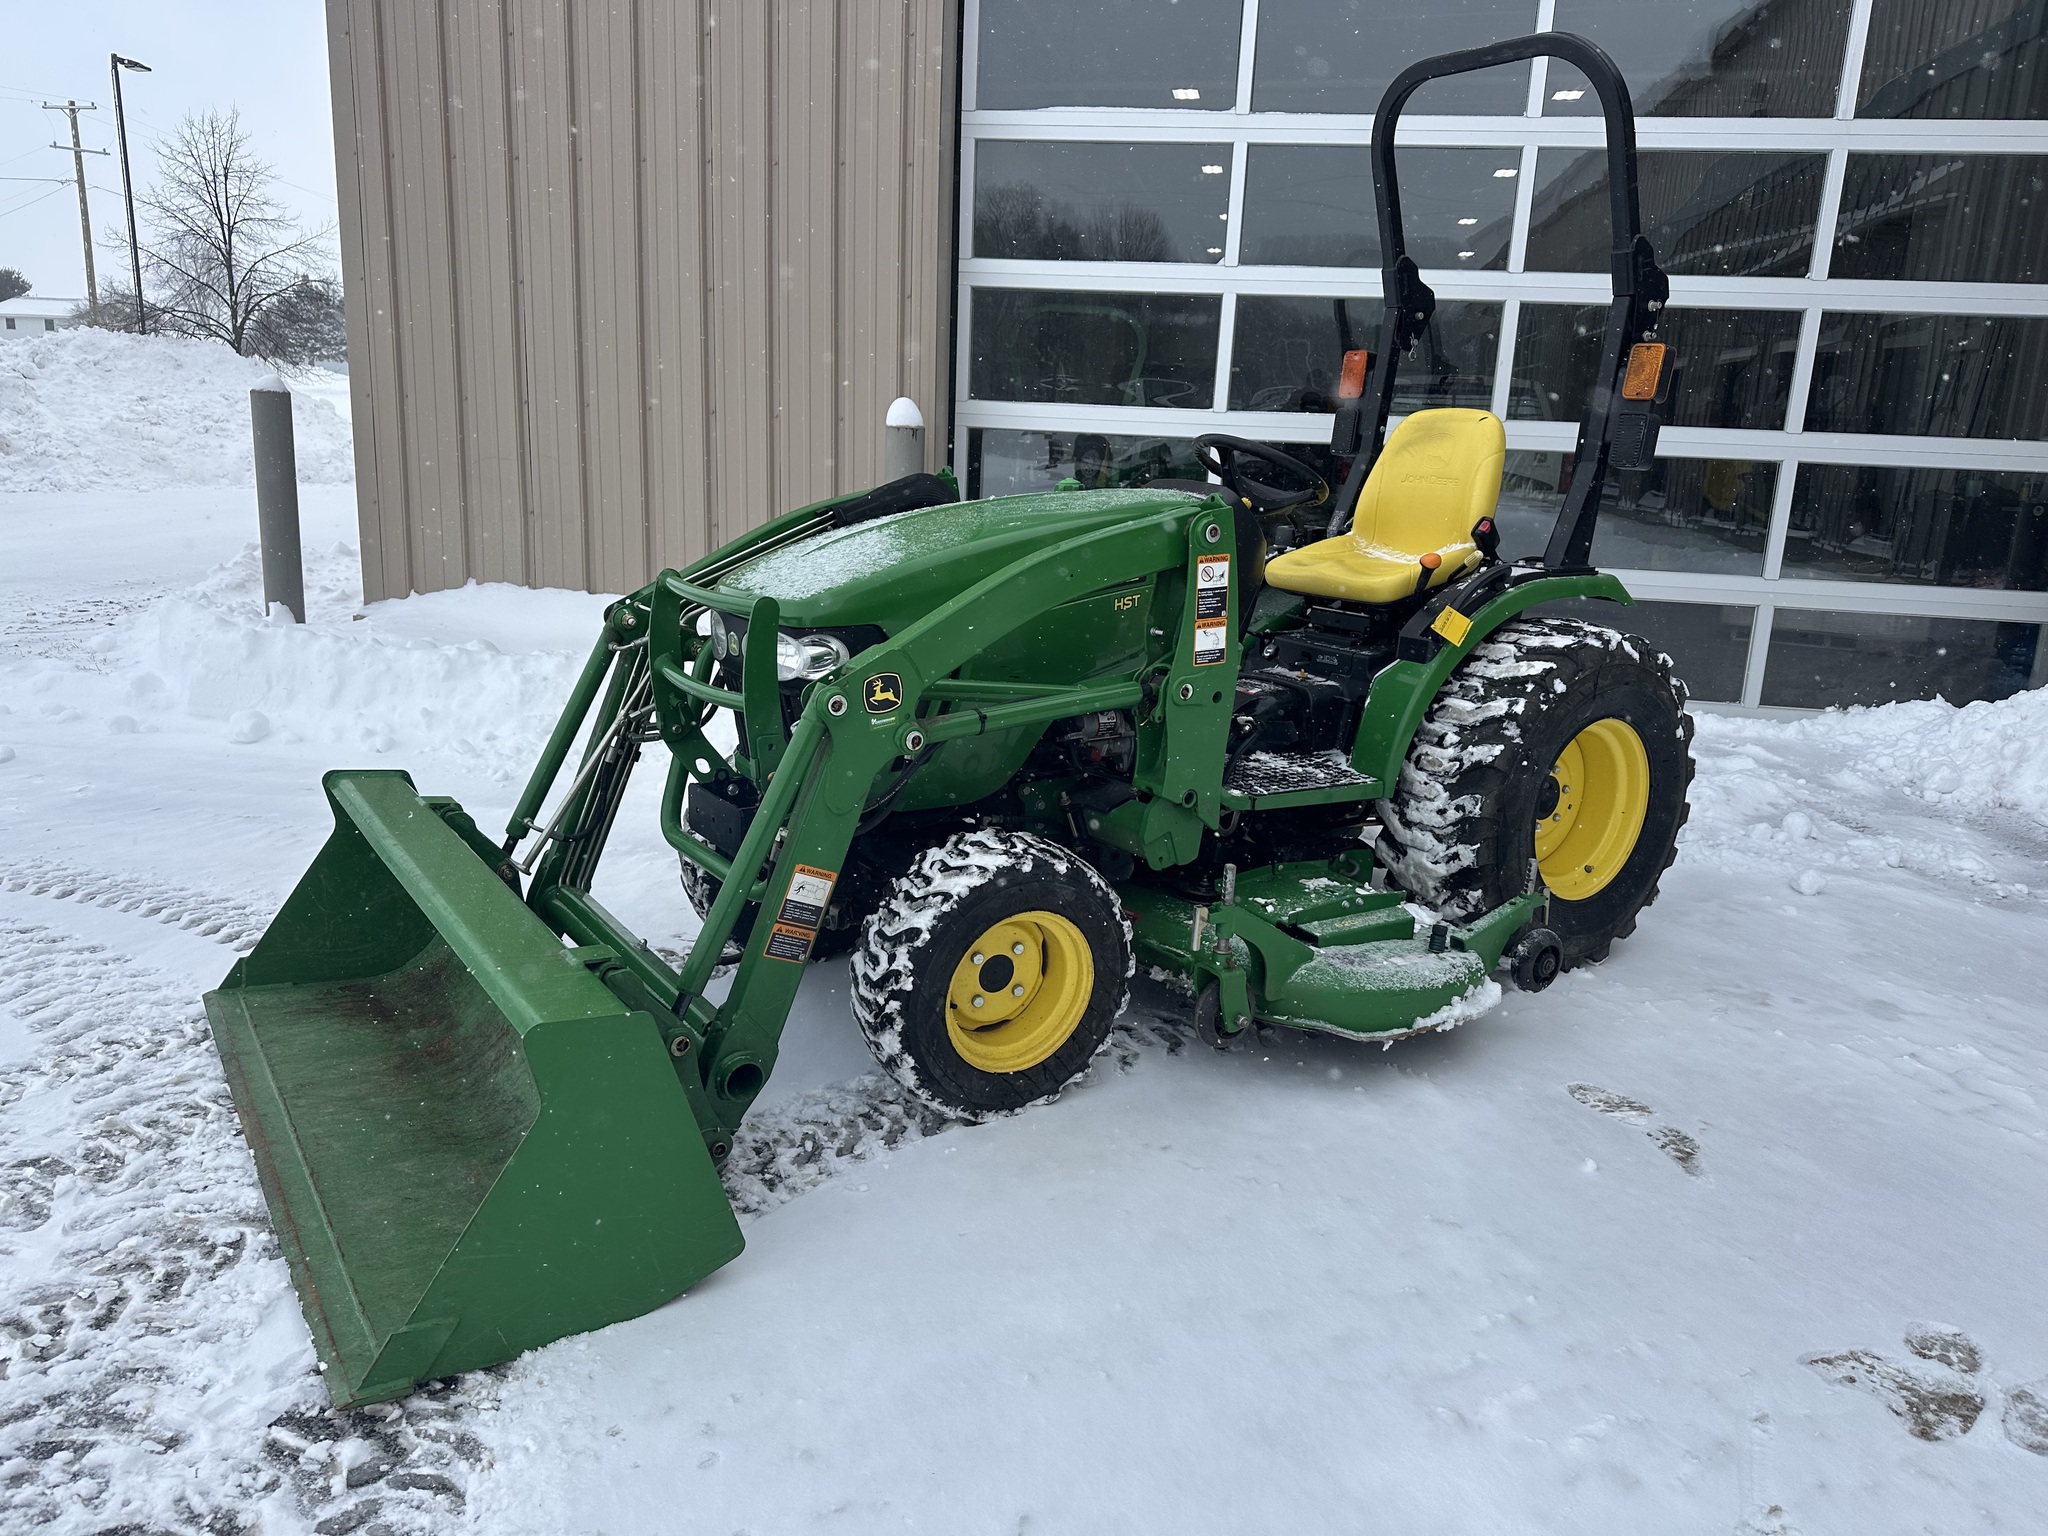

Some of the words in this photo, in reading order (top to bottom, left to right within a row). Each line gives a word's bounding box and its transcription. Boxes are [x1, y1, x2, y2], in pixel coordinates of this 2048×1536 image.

[1204, 555, 1229, 563] WARNING
[1114, 594, 1141, 611] HST
[1201, 620, 1226, 628] WARNING
[806, 868, 832, 879] WARNING
[784, 928, 810, 939] WARNING
